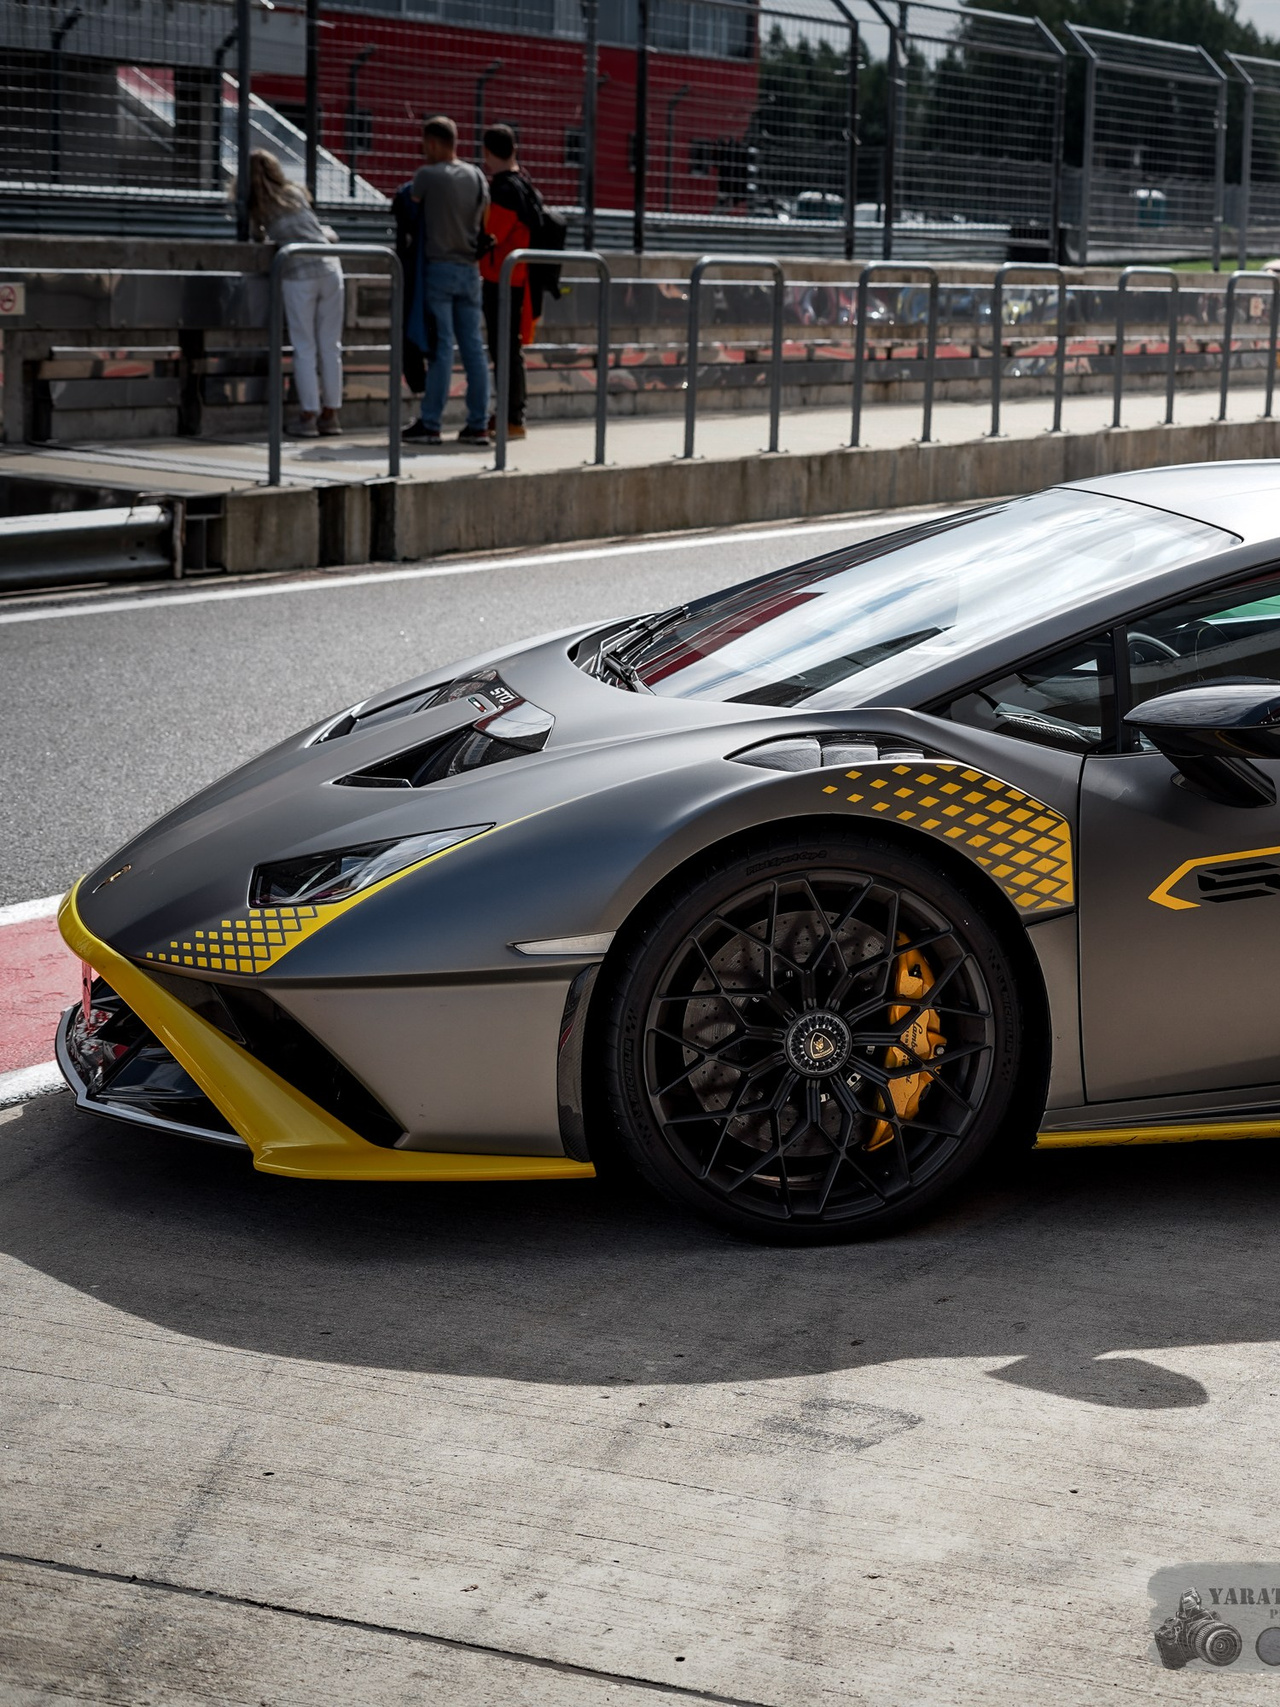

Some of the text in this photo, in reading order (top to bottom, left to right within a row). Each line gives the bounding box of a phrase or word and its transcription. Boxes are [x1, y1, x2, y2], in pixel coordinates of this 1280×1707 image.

[490, 687, 516, 704] STO
[1002, 990, 1014, 1053] MICHELIN
[624, 1038, 640, 1102] MICHELIN
